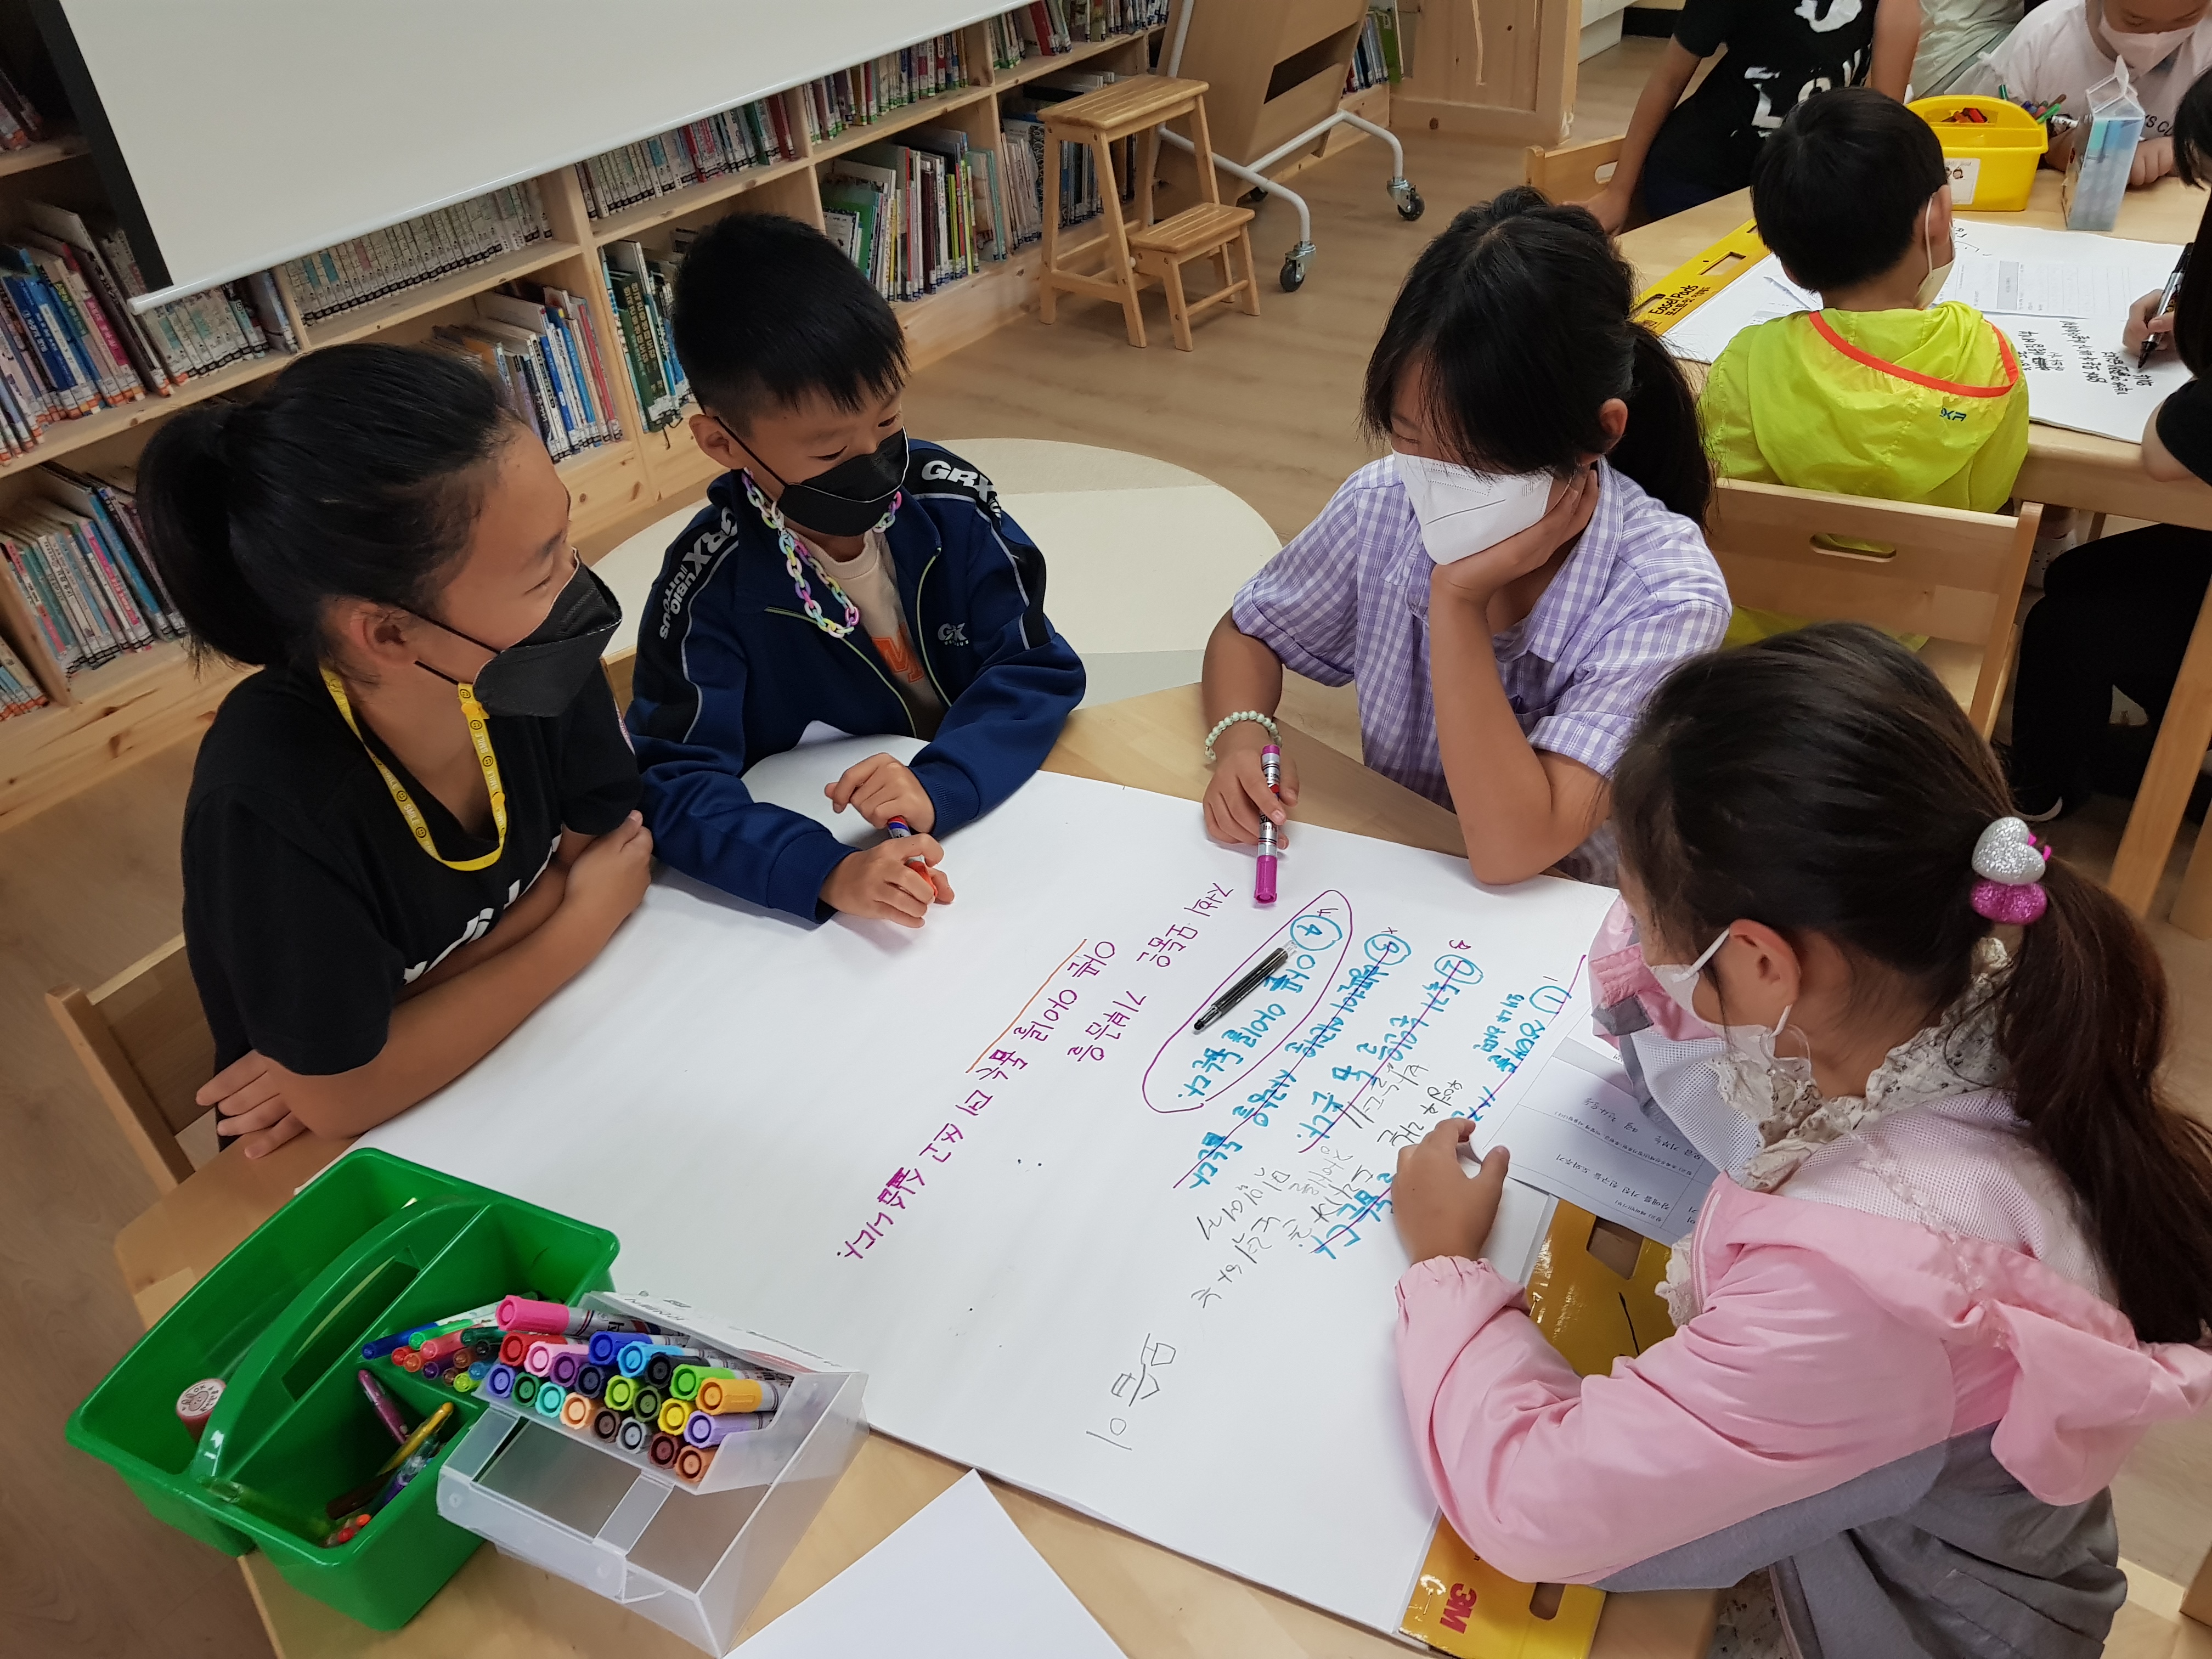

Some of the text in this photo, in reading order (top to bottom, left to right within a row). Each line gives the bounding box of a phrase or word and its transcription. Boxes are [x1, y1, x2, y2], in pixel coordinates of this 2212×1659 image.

[1648, 285, 1699, 314] Easel Pads
[921, 460, 995, 503] GRX
[682, 506, 738, 577] GRX
[670, 572, 697, 615] UBIQ
[473, 731, 489, 754] SMILE
[403, 803, 420, 827] SMILE
[1067, 883, 1234, 1062] 저희 모둠은 기부금을
[1263, 953, 1316, 994] 아픈
[1329, 964, 1390, 1013] 형편이
[1221, 1003, 1286, 1047] 아이를
[1356, 1014, 1430, 1062] 노인을
[1177, 1047, 1244, 1098] 돕는다.
[837, 941, 1115, 1259] 아픈 아이를 돕는 데 쓰고 싶습니다.
[1232, 1069, 1297, 1127] 사람을
[1419, 1079, 1464, 1115] 우영우
[1376, 1121, 1425, 1147] 라는
[1654, 1135, 1680, 1152] 기부는
[1188, 1131, 1244, 1190] 돕는다
[1288, 1144, 1354, 1196] 장애를
[1555, 1154, 1590, 1174] 도와주기
[1622, 1187, 1640, 1198] 가진
[1643, 1195, 1671, 1210] 장애를
[1086, 1333, 1176, 1451] 모습이
[1439, 1583, 1477, 1634] 3M
